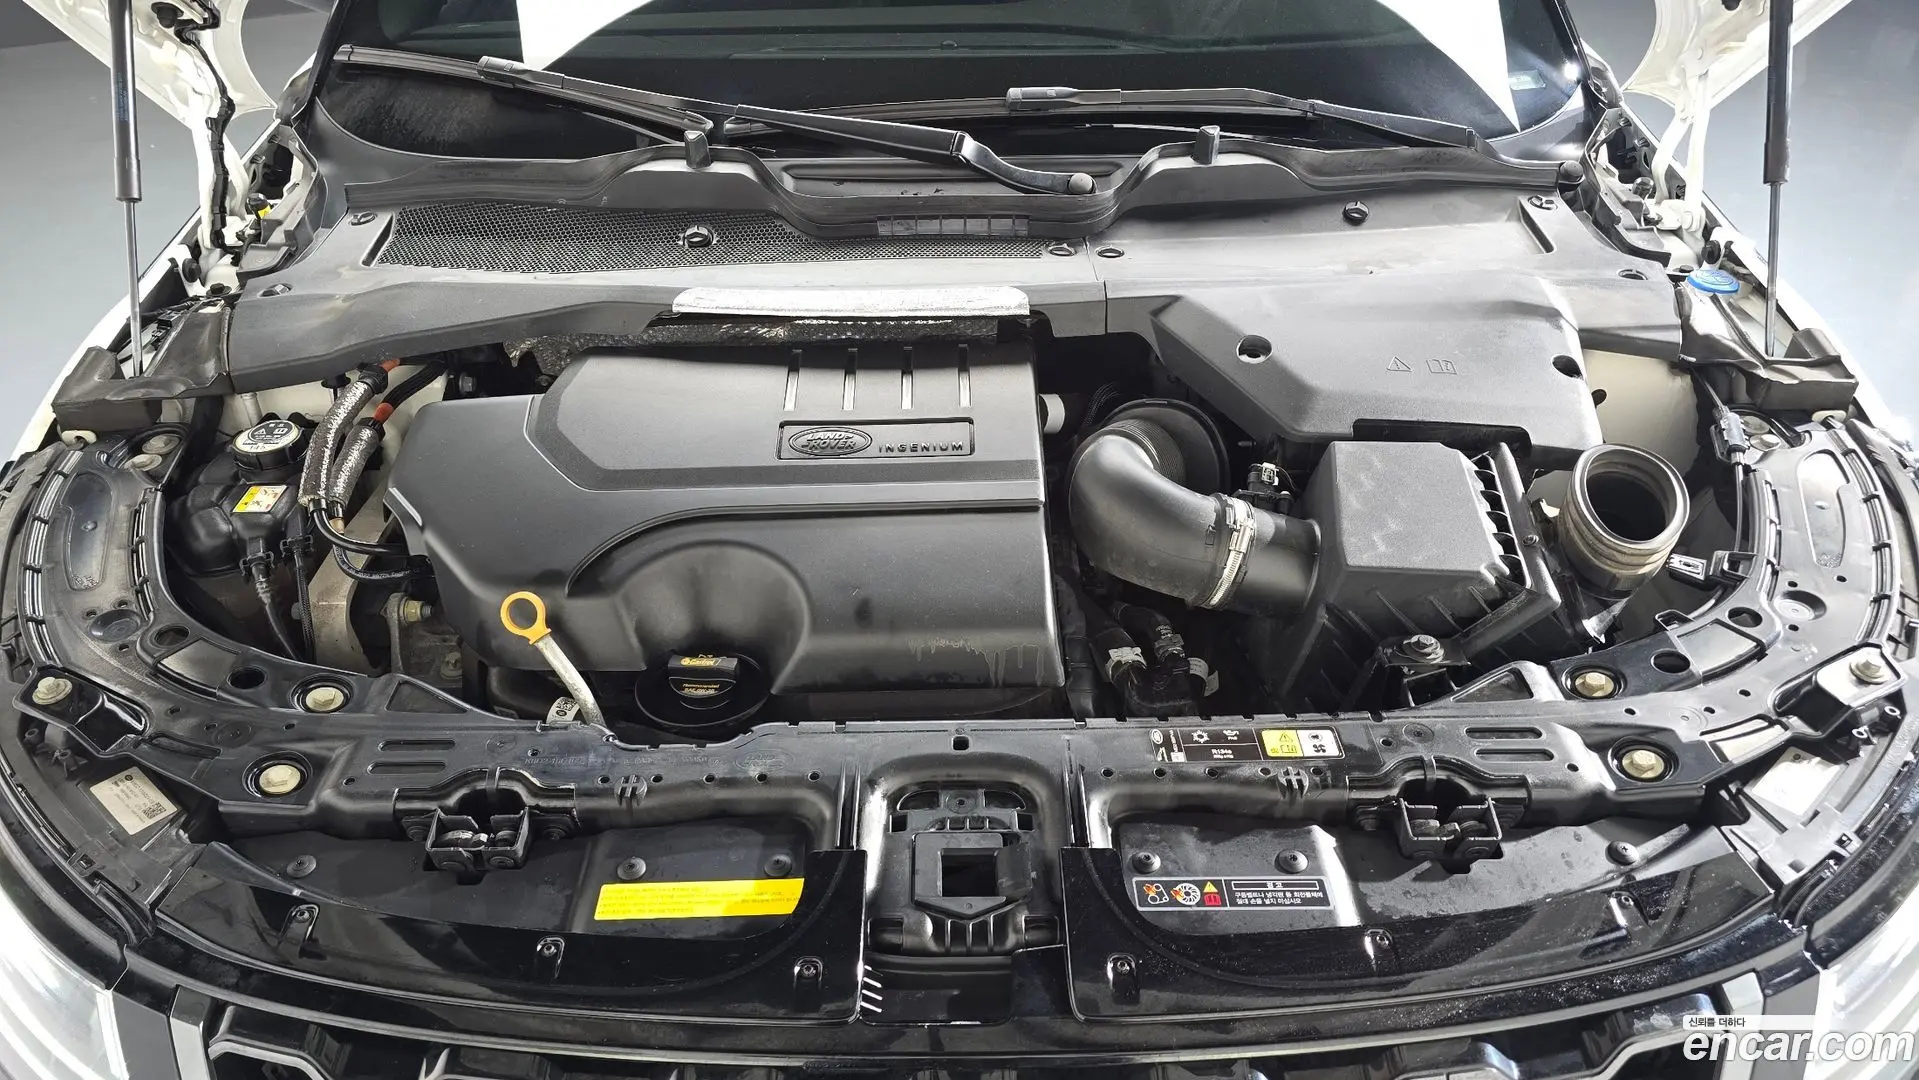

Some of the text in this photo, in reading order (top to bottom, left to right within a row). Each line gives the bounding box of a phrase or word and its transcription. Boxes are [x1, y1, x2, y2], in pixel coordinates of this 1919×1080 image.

[807, 431, 844, 441] LAND
[808, 440, 857, 450] ROVER
[879, 441, 964, 453] INGENIUM
